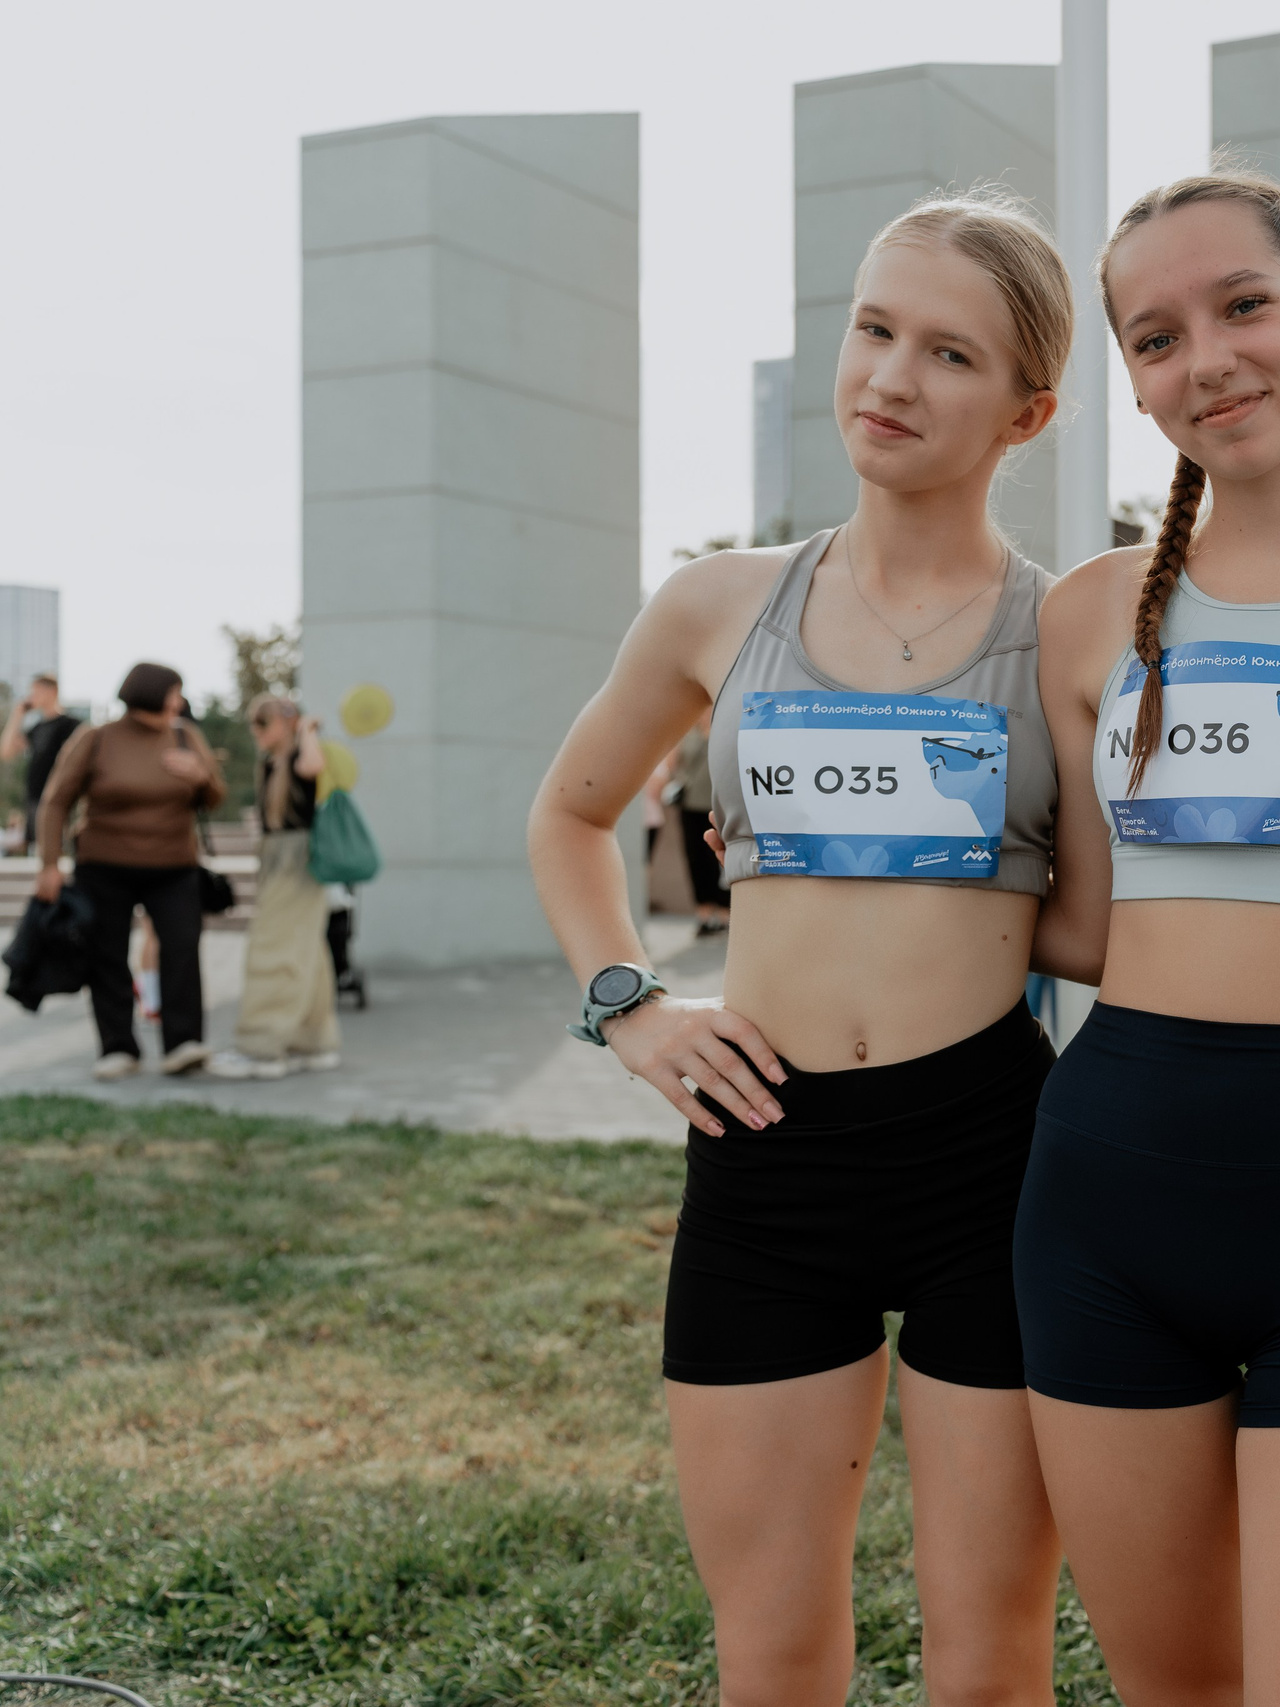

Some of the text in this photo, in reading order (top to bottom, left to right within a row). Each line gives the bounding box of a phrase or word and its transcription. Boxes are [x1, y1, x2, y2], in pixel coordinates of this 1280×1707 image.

[1171, 653, 1248, 669] волонтёров
[775, 702, 988, 720] Забег волонтёров Южного Урала
[1168, 722, 1250, 755] 036
[814, 765, 899, 795] 035
